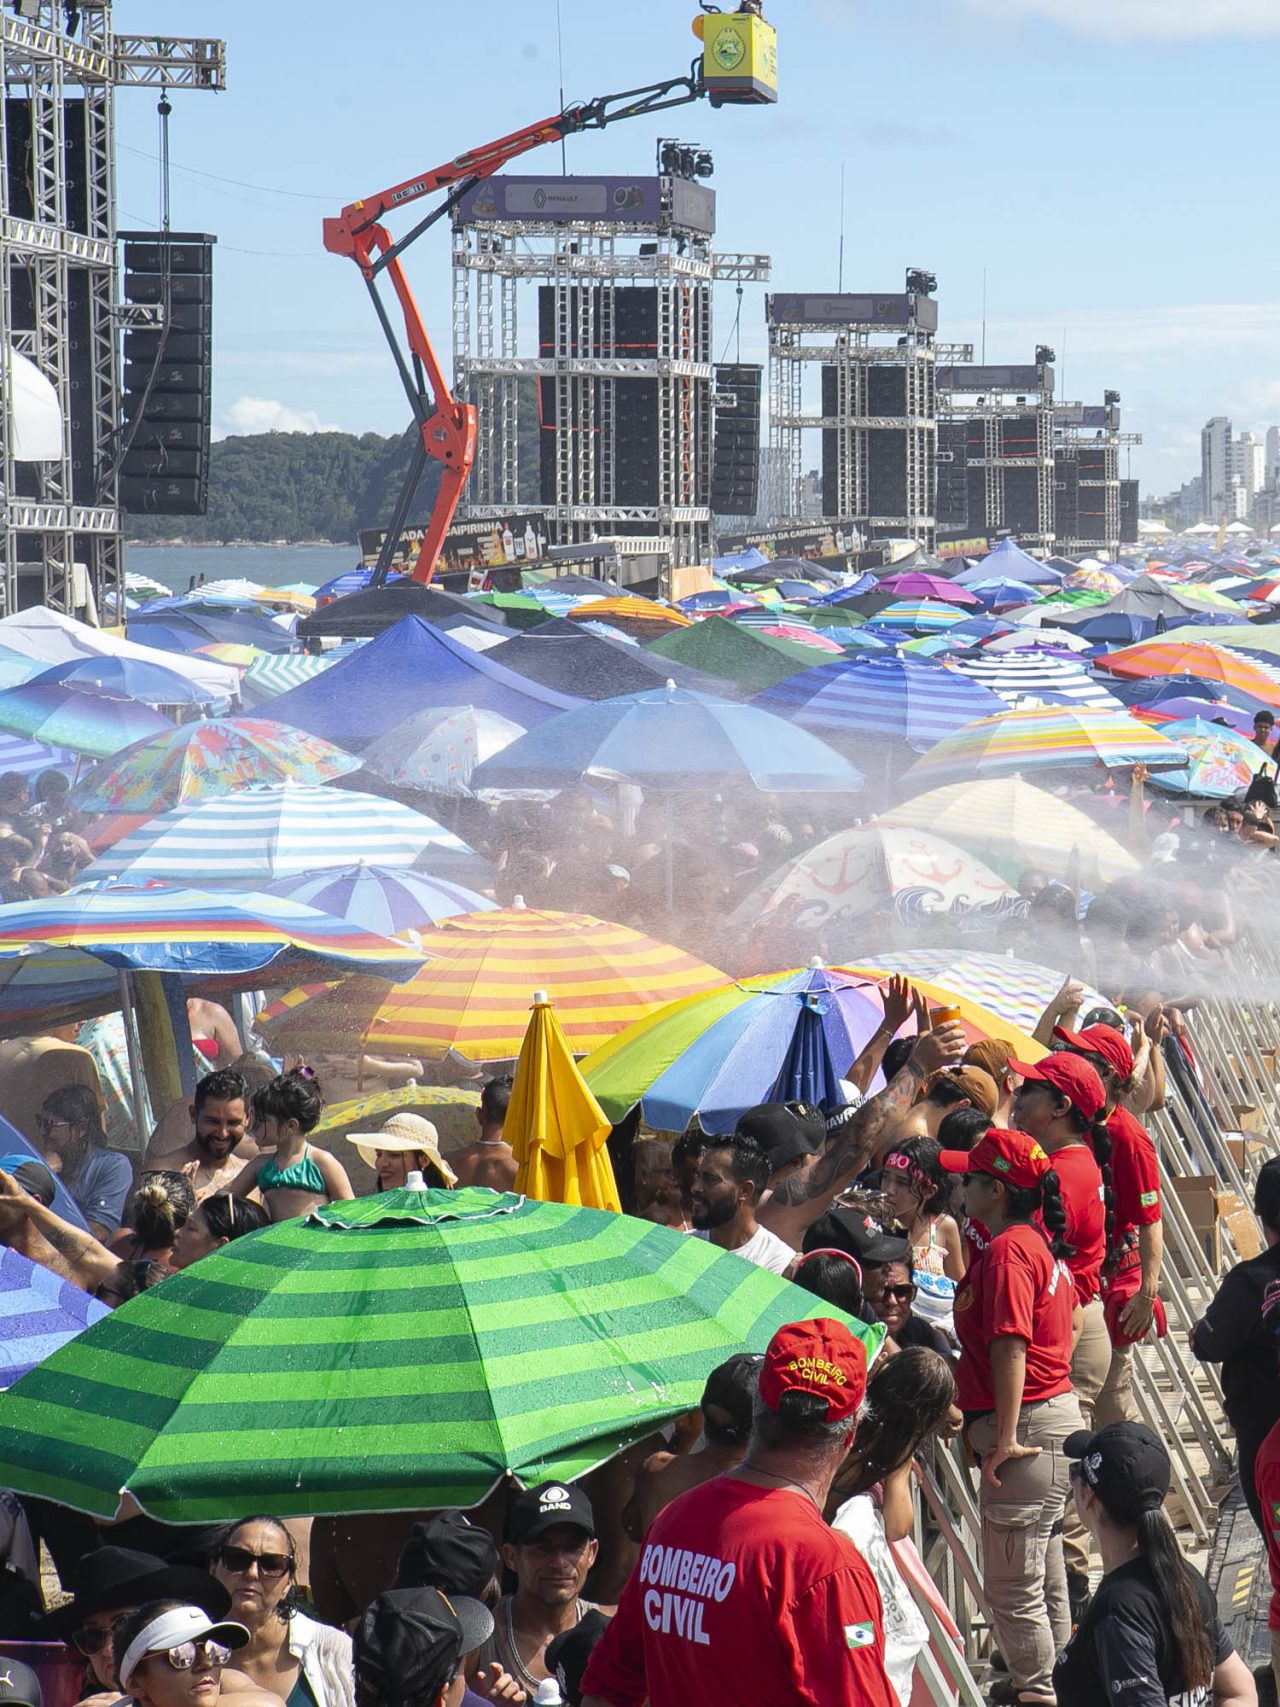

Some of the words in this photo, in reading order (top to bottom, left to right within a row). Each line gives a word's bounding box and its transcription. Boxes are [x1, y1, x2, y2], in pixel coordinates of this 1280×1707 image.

[789, 1357, 847, 1386] BOMBEIRO
[801, 1368, 830, 1385] CIVIL
[539, 1502, 572, 1513] BAND
[639, 1544, 736, 1602] BOMBEIRO
[644, 1589, 711, 1646] CIVIL
